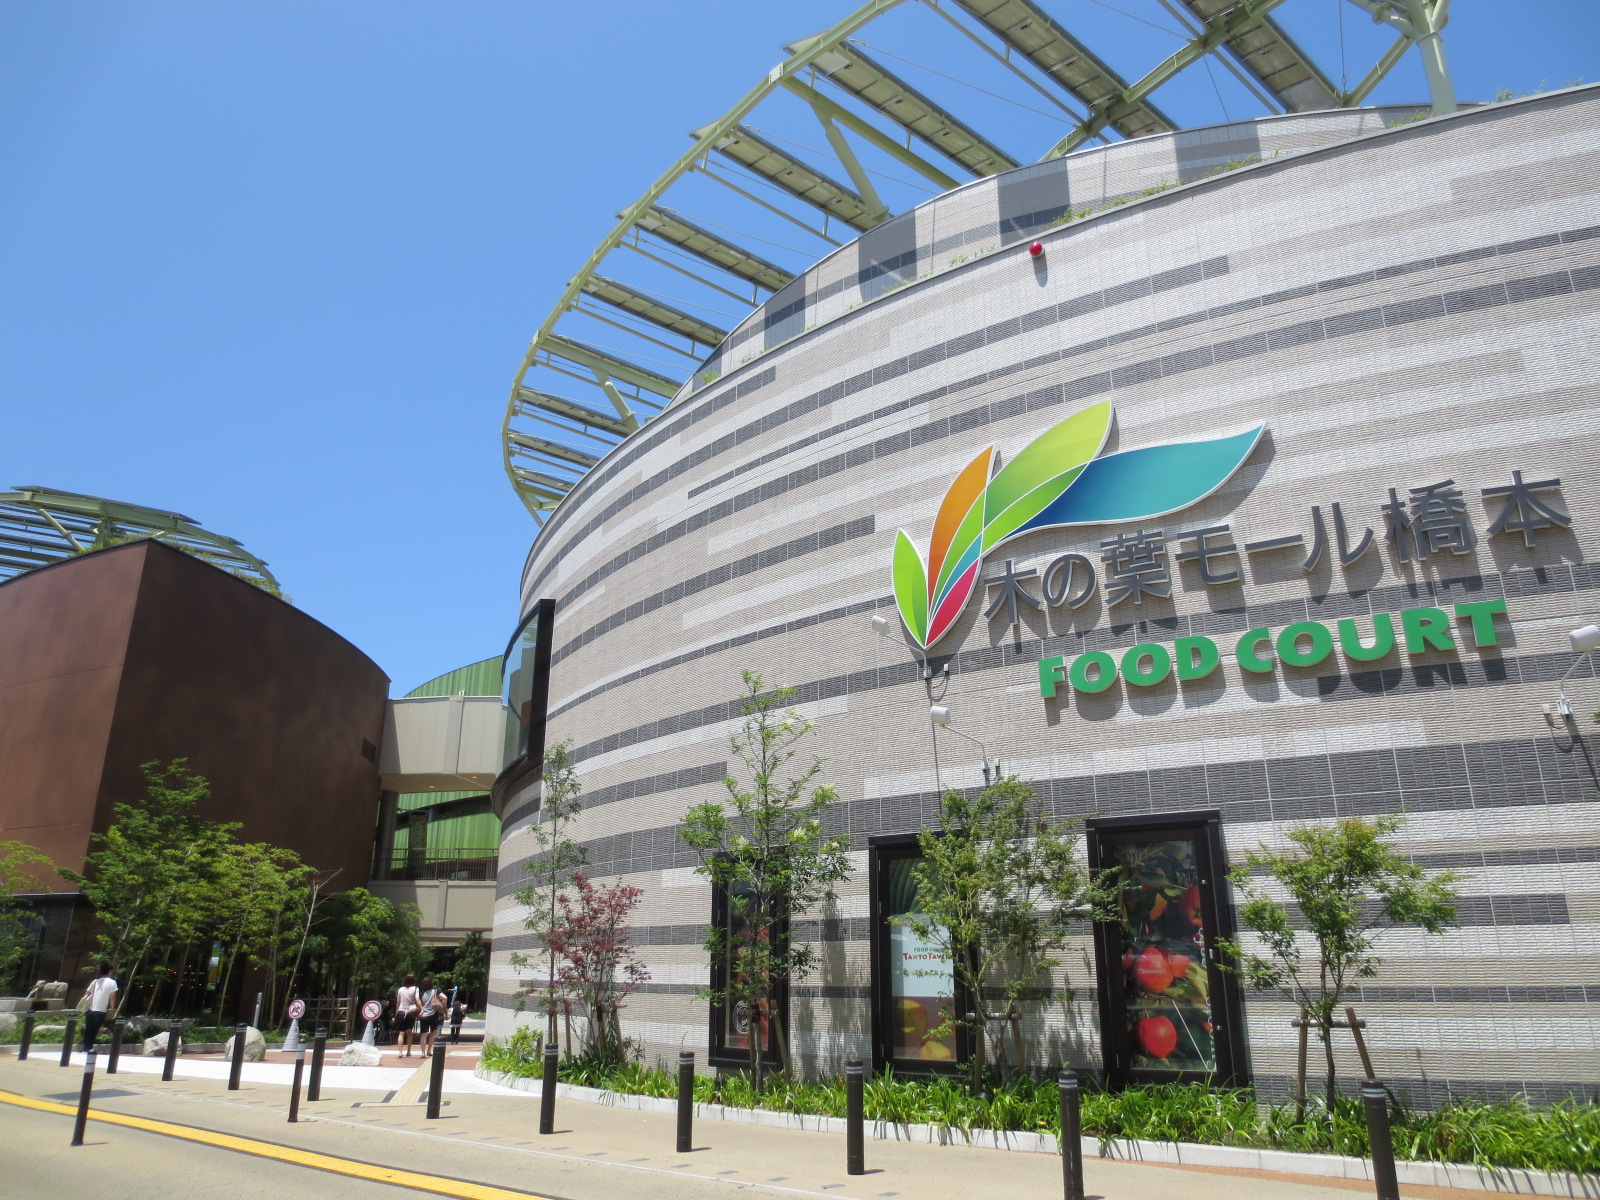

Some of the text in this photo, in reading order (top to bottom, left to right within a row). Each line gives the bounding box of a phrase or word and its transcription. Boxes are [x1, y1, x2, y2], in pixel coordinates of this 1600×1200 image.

[984, 470, 1572, 625] 木の葉モール橋本
[1039, 600, 1507, 698] FOOD COURT
